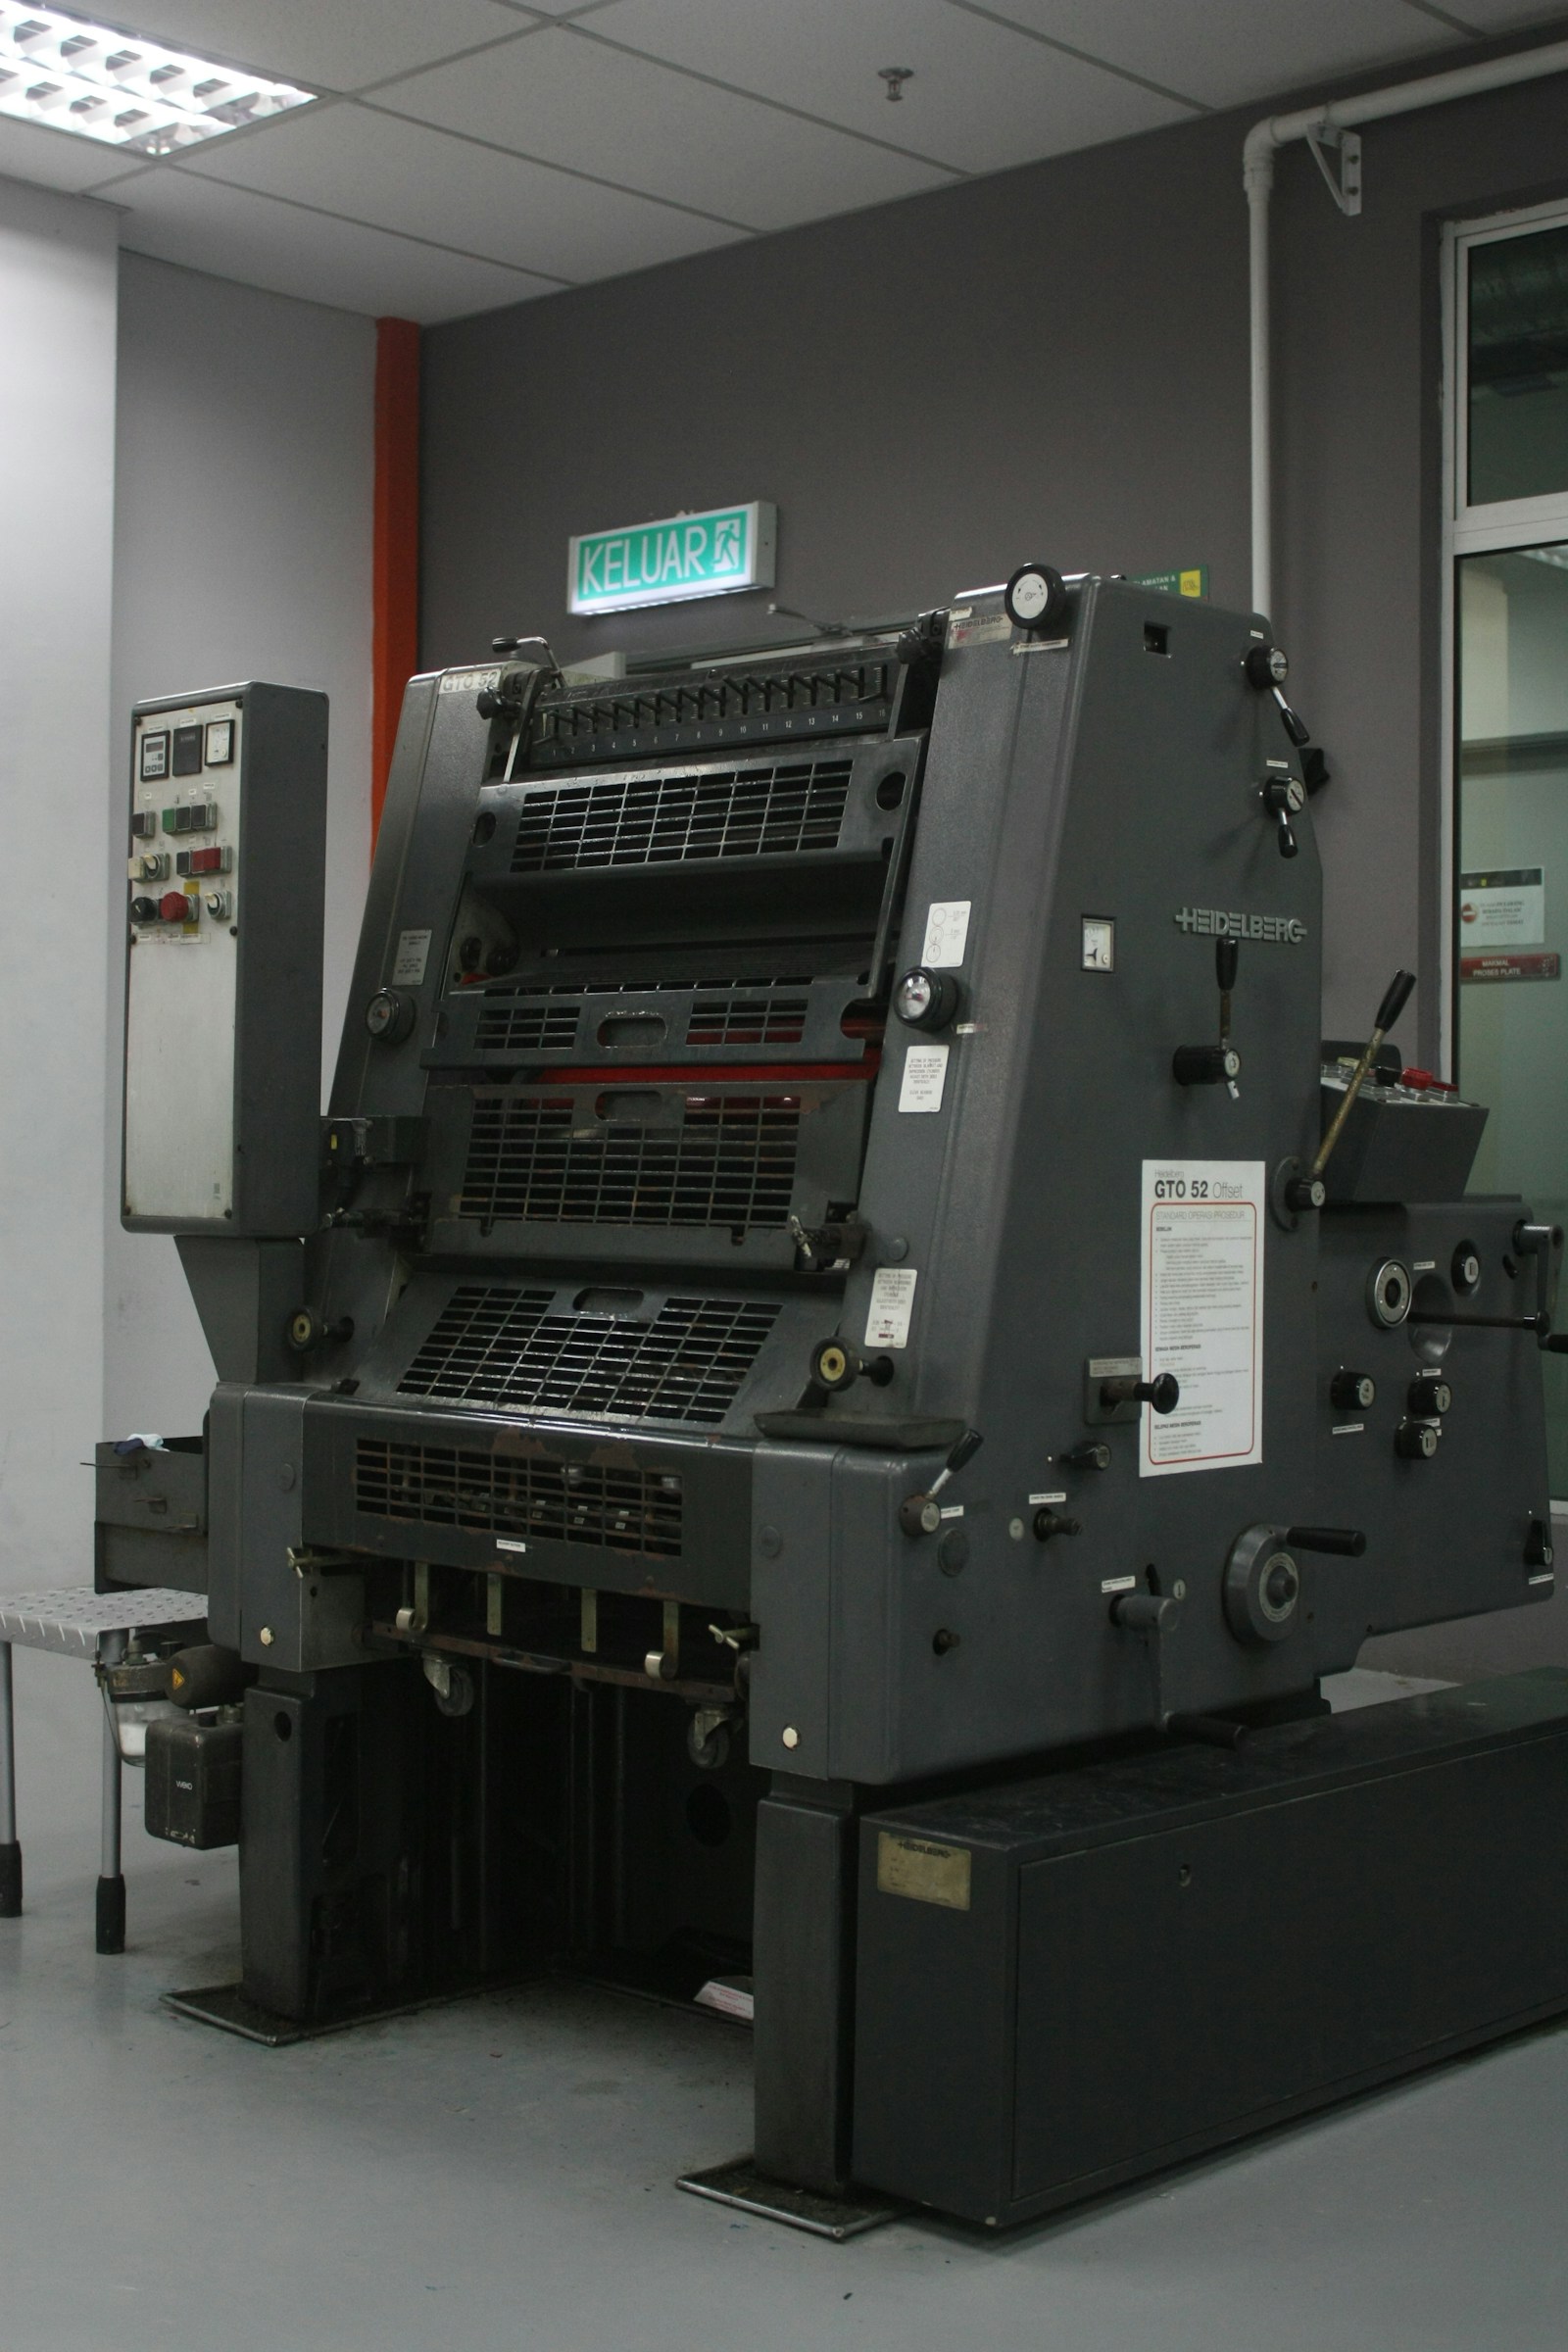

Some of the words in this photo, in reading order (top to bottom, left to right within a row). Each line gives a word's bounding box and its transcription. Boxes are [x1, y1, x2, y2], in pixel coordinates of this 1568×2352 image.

[582, 525, 709, 596] KELUAR
[442, 672, 474, 692] GTO
[478, 670, 498, 688] 52
[740, 725, 747, 734] 10
[1175, 906, 1308, 945] HEIDELBERG
[1473, 968, 1498, 977] PROSES
[1500, 967, 1521, 976] PLATE
[1154, 1169, 1184, 1179] Heidelberg
[1154, 1179, 1186, 1199] GTO
[1191, 1180, 1208, 1199] 52
[1212, 1181, 1243, 1199] Offset
[1156, 1210, 1187, 1220] STANDARD
[1188, 1210, 1212, 1220] OPERASI
[1213, 1210, 1246, 1220] PROSEDUR
